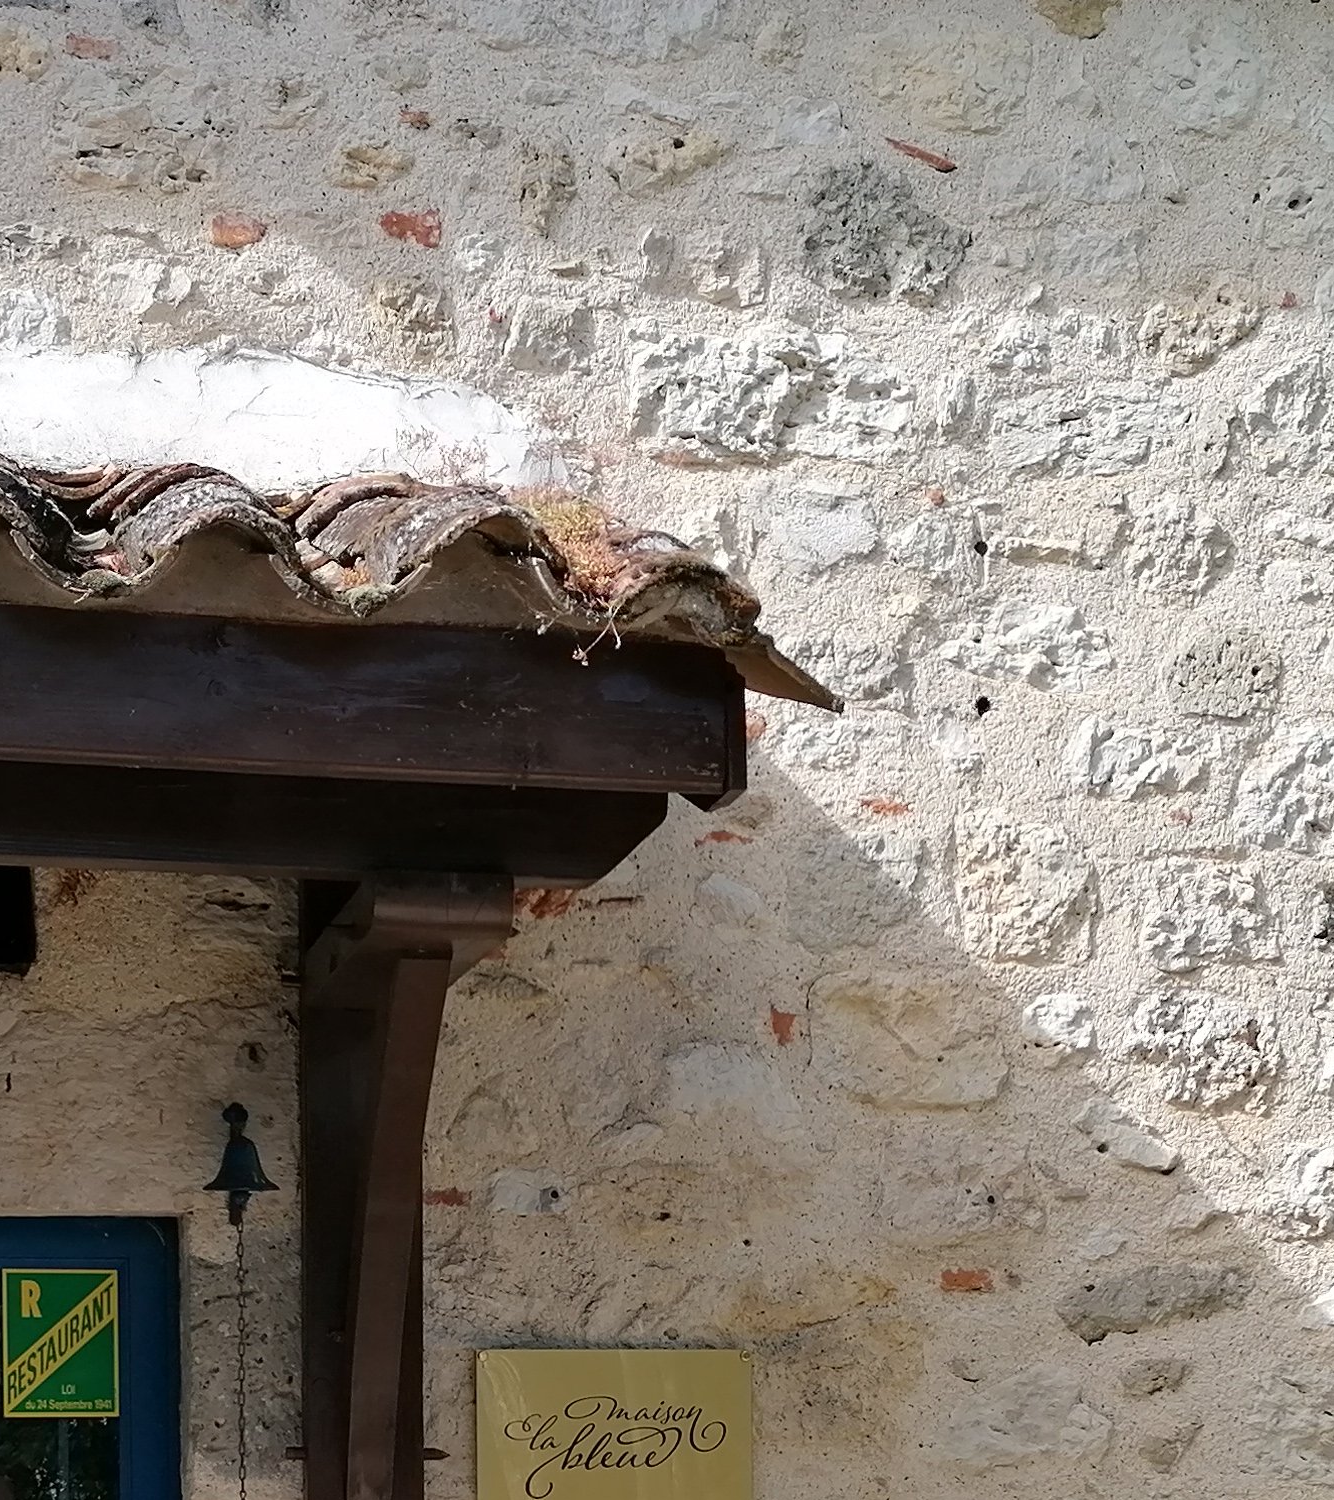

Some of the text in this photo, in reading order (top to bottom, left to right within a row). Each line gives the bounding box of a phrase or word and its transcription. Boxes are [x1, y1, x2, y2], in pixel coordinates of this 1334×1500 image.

[20, 1279, 42, 1318] R
[7, 1282, 114, 1405] RESTAURANT
[25, 1400, 36, 1410] du
[37, 1399, 47, 1410] 24
[48, 1399, 93, 1411] Septembre
[61, 1384, 76, 1395] LOI
[564, 1395, 727, 1453] maison
[525, 1423, 683, 1500] bleue
